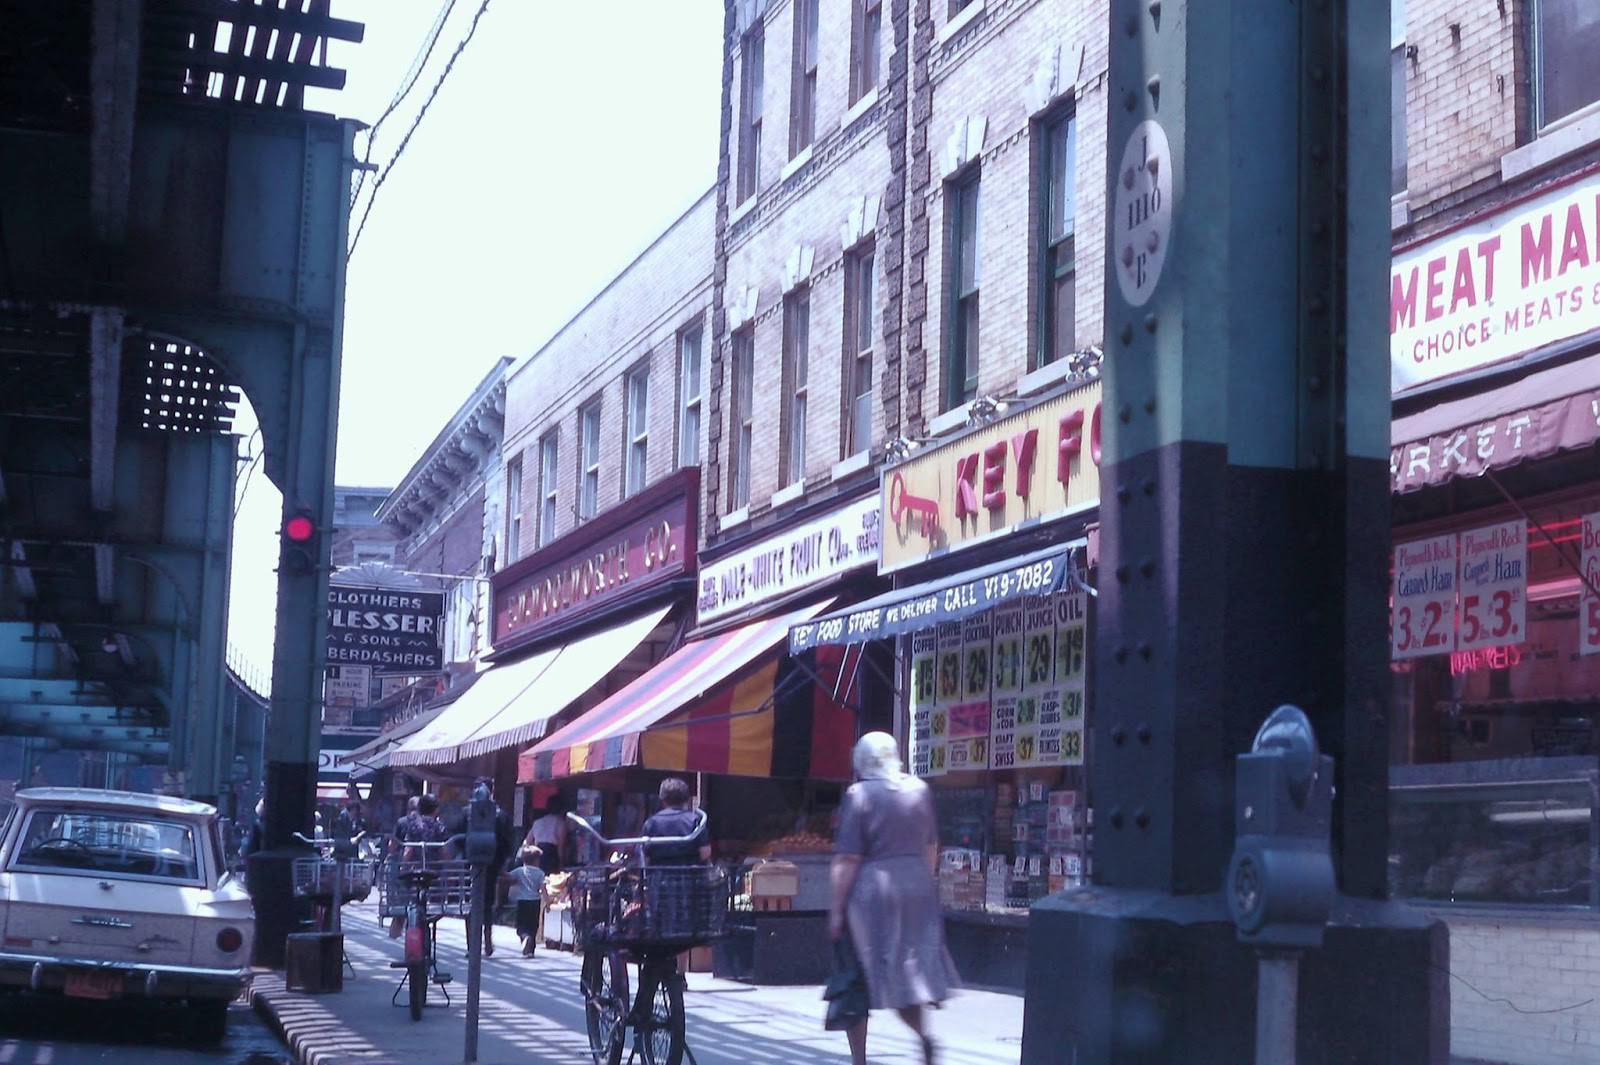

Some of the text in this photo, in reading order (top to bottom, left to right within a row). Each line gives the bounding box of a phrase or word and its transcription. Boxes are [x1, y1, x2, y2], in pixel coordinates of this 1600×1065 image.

[1138, 135, 1147, 172] J
[1391, 194, 1600, 334] MEAT MA
[1413, 317, 1491, 364] CHOICE
[1504, 284, 1584, 335] MEATS
[954, 428, 1039, 518] KEY
[1501, 524, 1521, 547] Rock
[790, 531, 823, 579] FRUIT
[1492, 552, 1521, 584] Ham
[1431, 566, 1453, 591] Ham
[328, 592, 422, 609] CLOTHIERS
[1058, 599, 1083, 625] OIL
[326, 609, 434, 634] LESSER
[793, 625, 814, 647] KEY
[816, 618, 842, 641] FOOD
[847, 608, 880, 635] STORE
[901, 598, 937, 621] DELIVER
[944, 584, 977, 612] CALL
[1026, 608, 1053, 631] JUICE
[1397, 606, 1412, 651] 3
[1463, 595, 1480, 643] 5
[359, 635, 401, 647] SONS
[913, 637, 935, 654] COFFEE
[328, 647, 436, 667] BERDASHERS
[1030, 636, 1052, 683] 29
[994, 751, 1014, 767] SWISS
